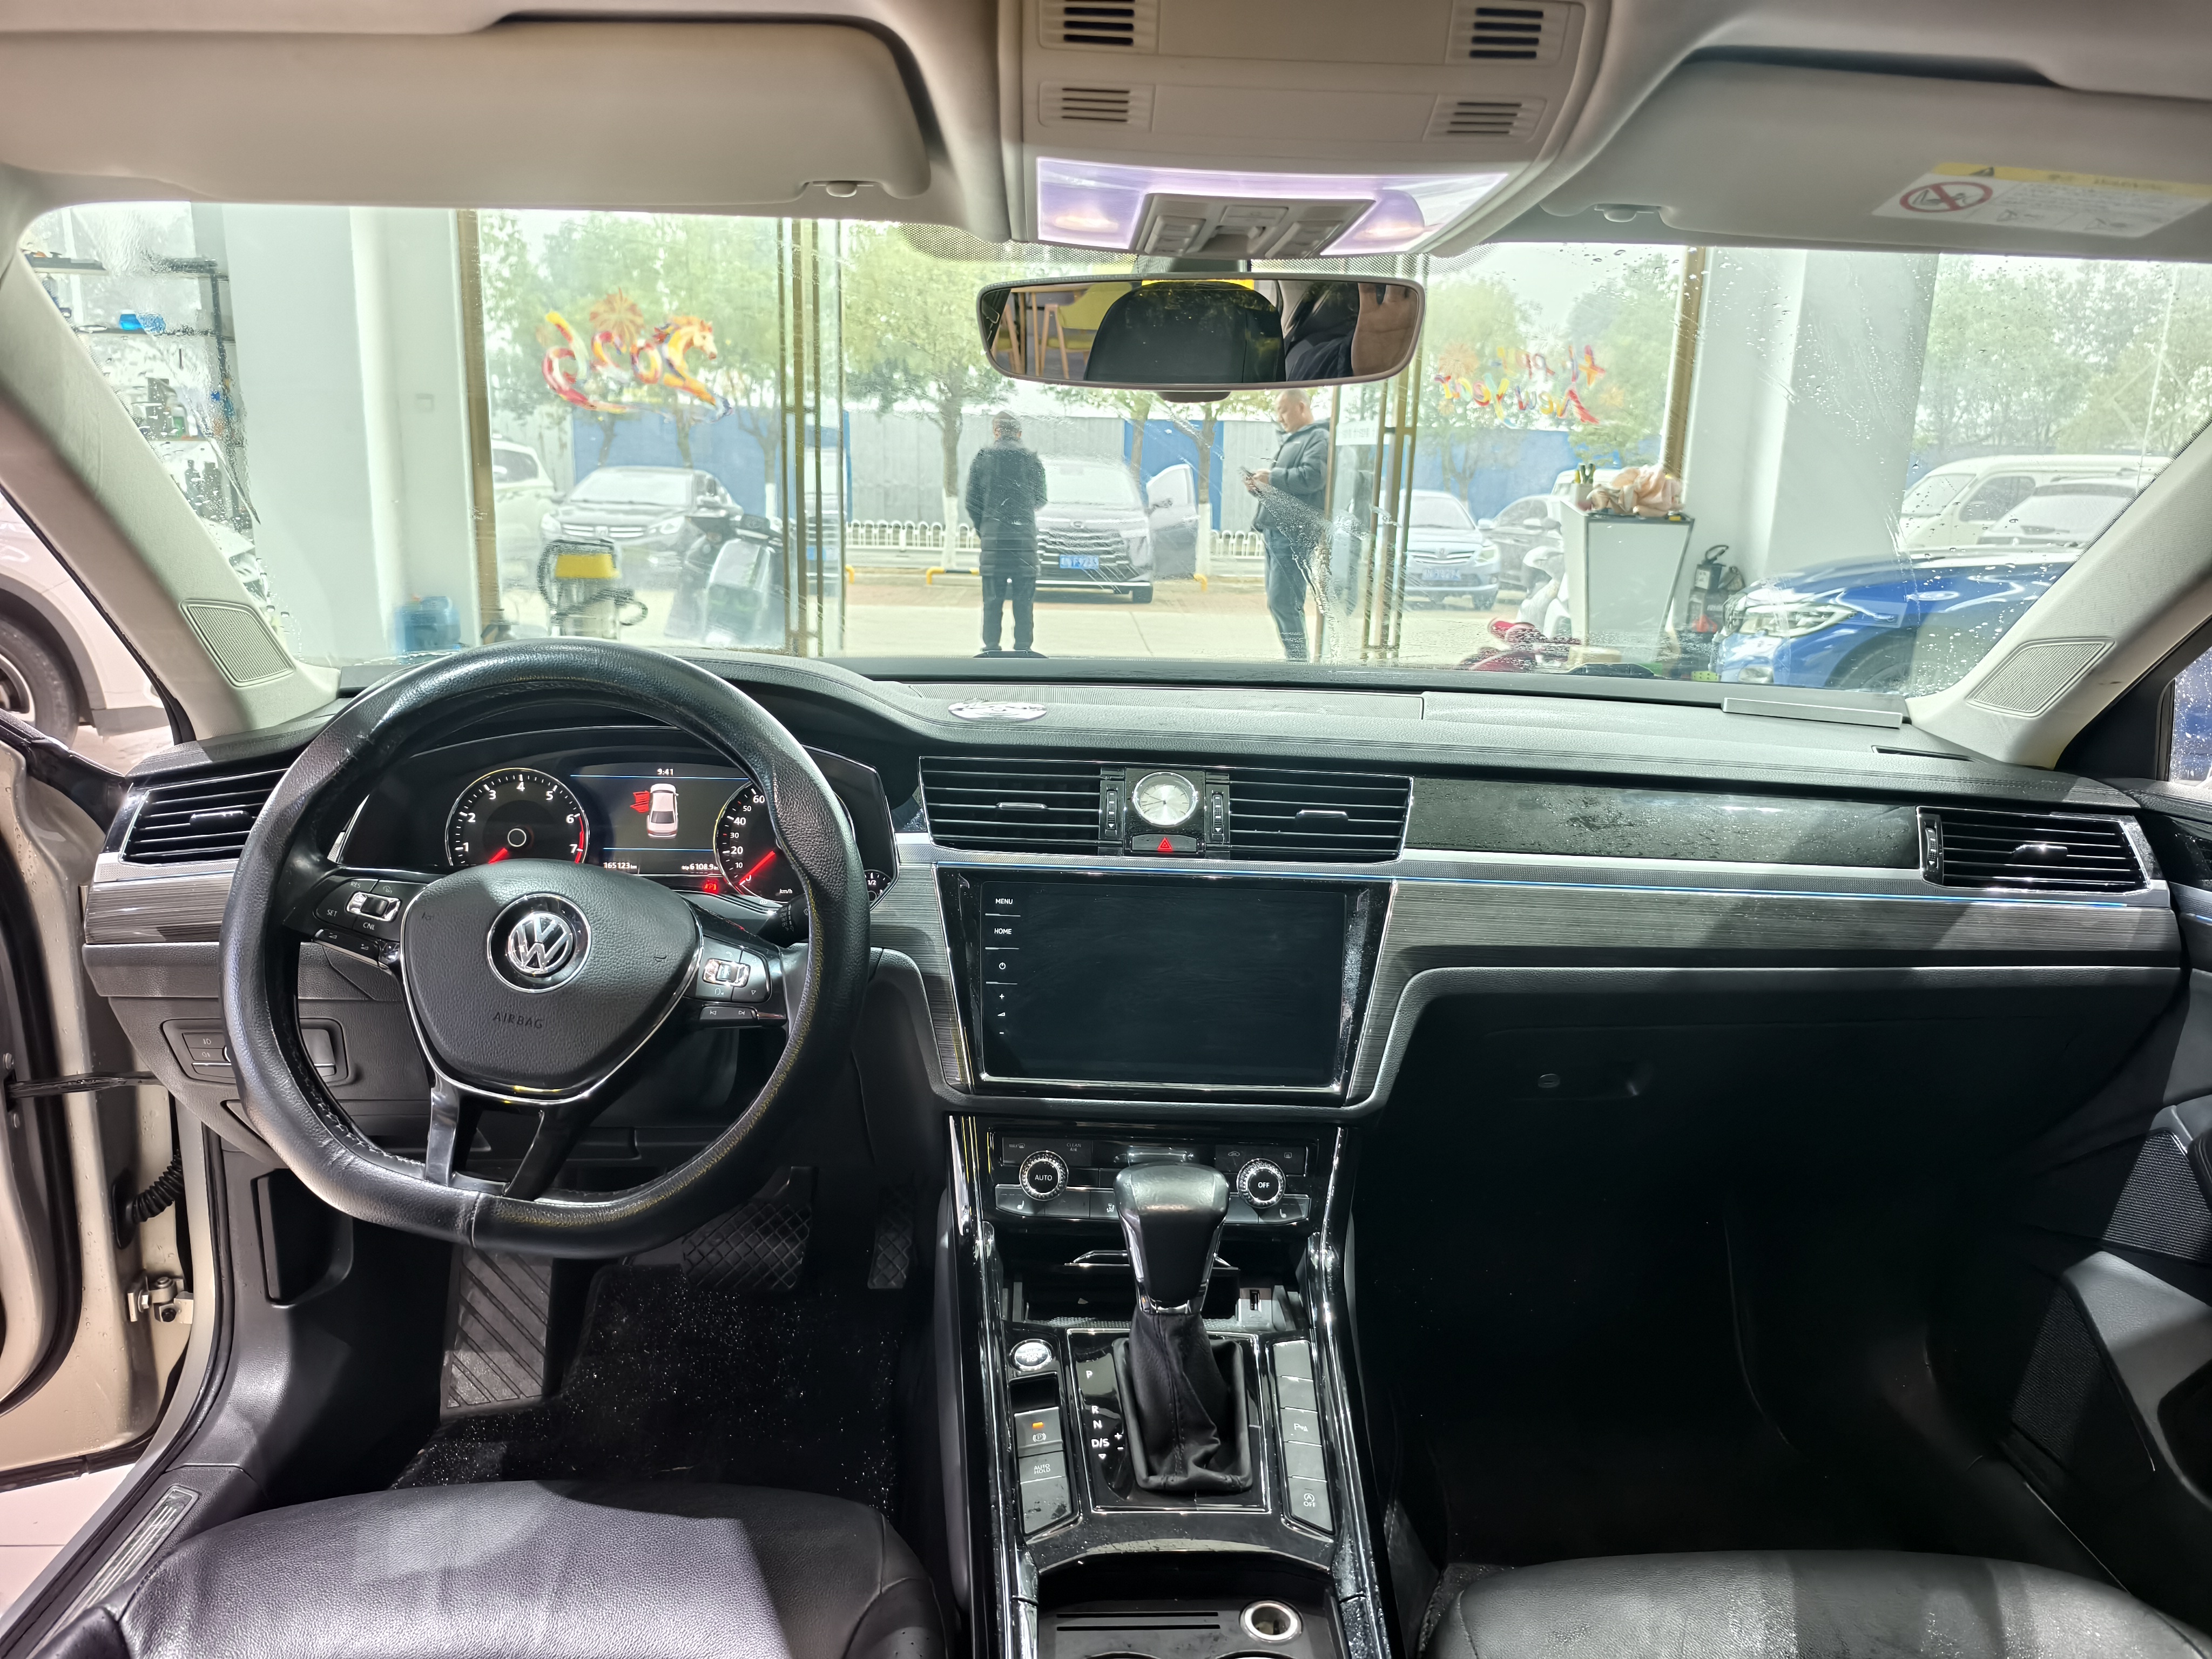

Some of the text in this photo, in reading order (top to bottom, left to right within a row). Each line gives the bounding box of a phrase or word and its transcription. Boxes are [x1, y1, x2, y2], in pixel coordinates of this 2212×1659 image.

[516, 782, 525, 791] 4
[489, 790, 496, 799] 3
[546, 791, 554, 800] 5
[468, 813, 476, 822] 2
[566, 814, 575, 823] 6
[733, 817, 746, 825] 40
[463, 842, 469, 852] 1
[569, 844, 578, 853] 7
[363, 922, 375, 930] CNL
[493, 1011, 543, 1029] AIRBAG
[1086, 1370, 1093, 1379] P
[1091, 1405, 1100, 1414] R
[1093, 1420, 1103, 1429] N
[1091, 1438, 1110, 1448] D/S
